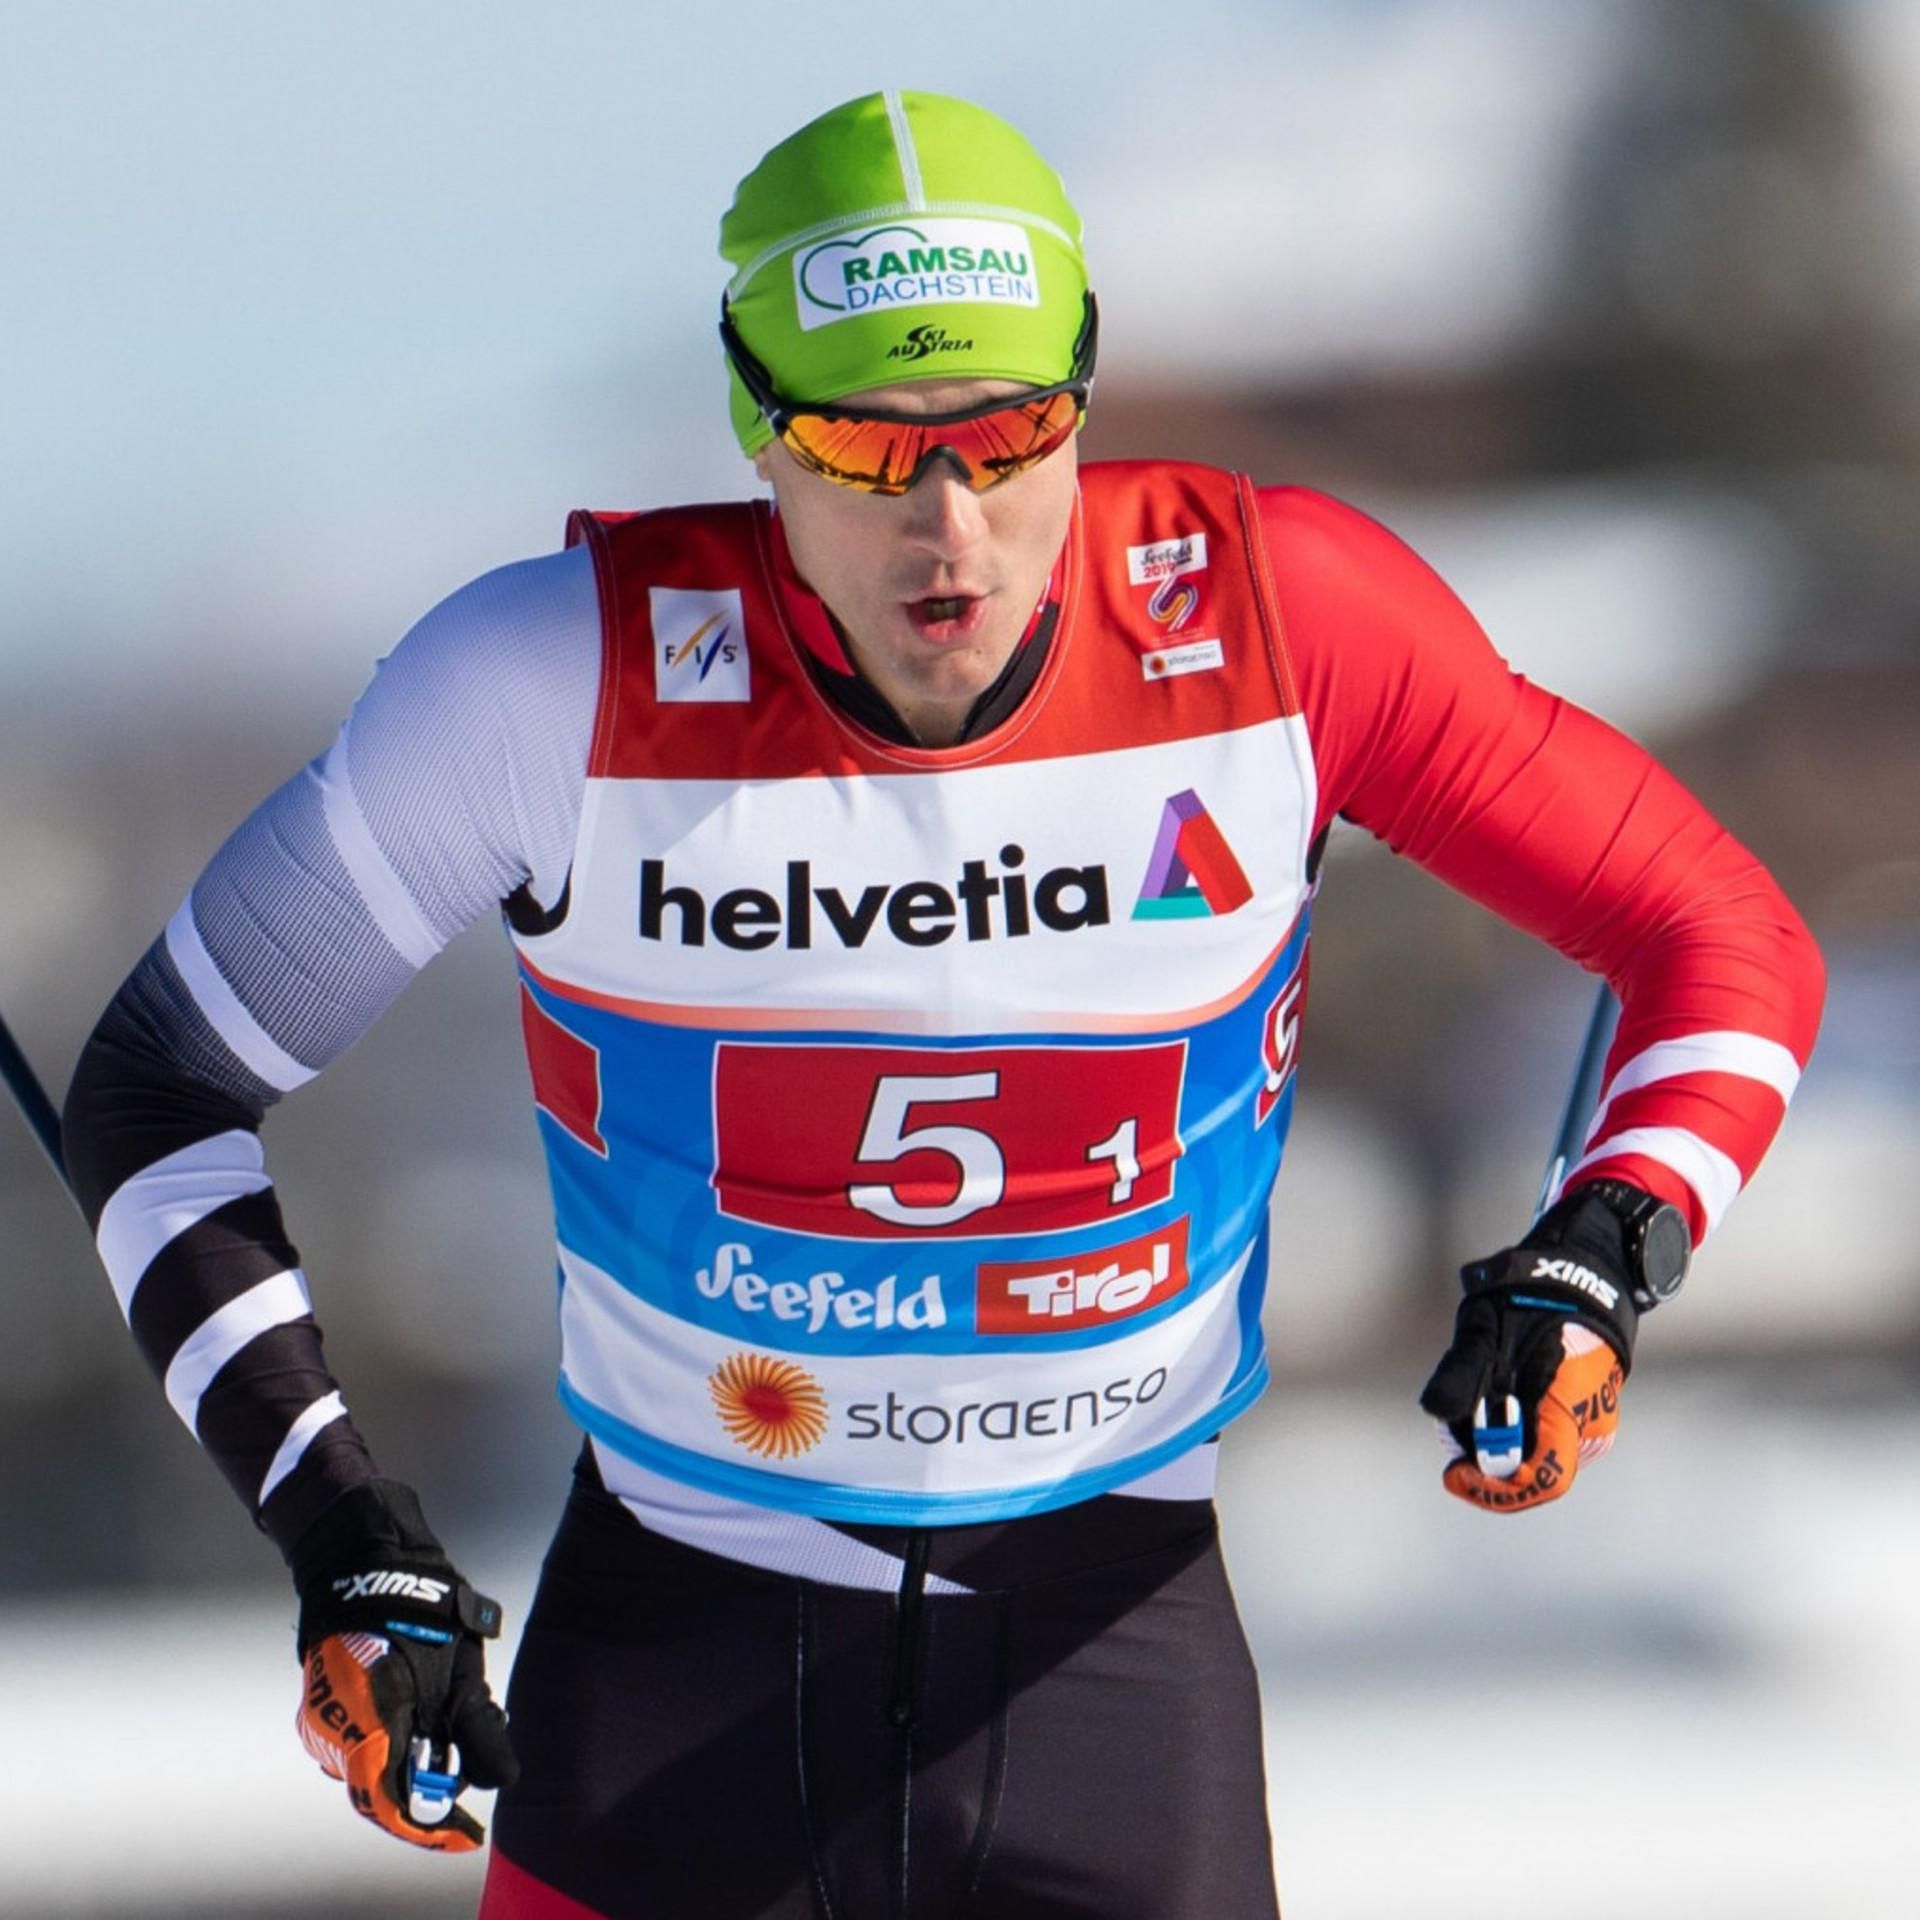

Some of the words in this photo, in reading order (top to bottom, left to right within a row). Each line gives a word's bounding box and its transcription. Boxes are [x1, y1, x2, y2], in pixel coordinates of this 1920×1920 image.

[842, 246, 1028, 286] RAMSAU
[848, 275, 1034, 309] DACHSTEIN
[886, 336, 974, 362] AUSTRIA
[903, 324, 946, 362] SKI
[1143, 563, 1176, 578] 2019
[664, 644, 738, 665] FIS
[639, 843, 1111, 951] helvetia
[847, 1070, 1007, 1228] 5
[1087, 1117, 1141, 1206] 1
[695, 1241, 948, 1335] Seefeld
[1007, 1242, 1171, 1319] Tirol
[1531, 1257, 1620, 1311] SWIX
[846, 1367, 1168, 1446] storaenso
[343, 1570, 451, 1603] SWIX
